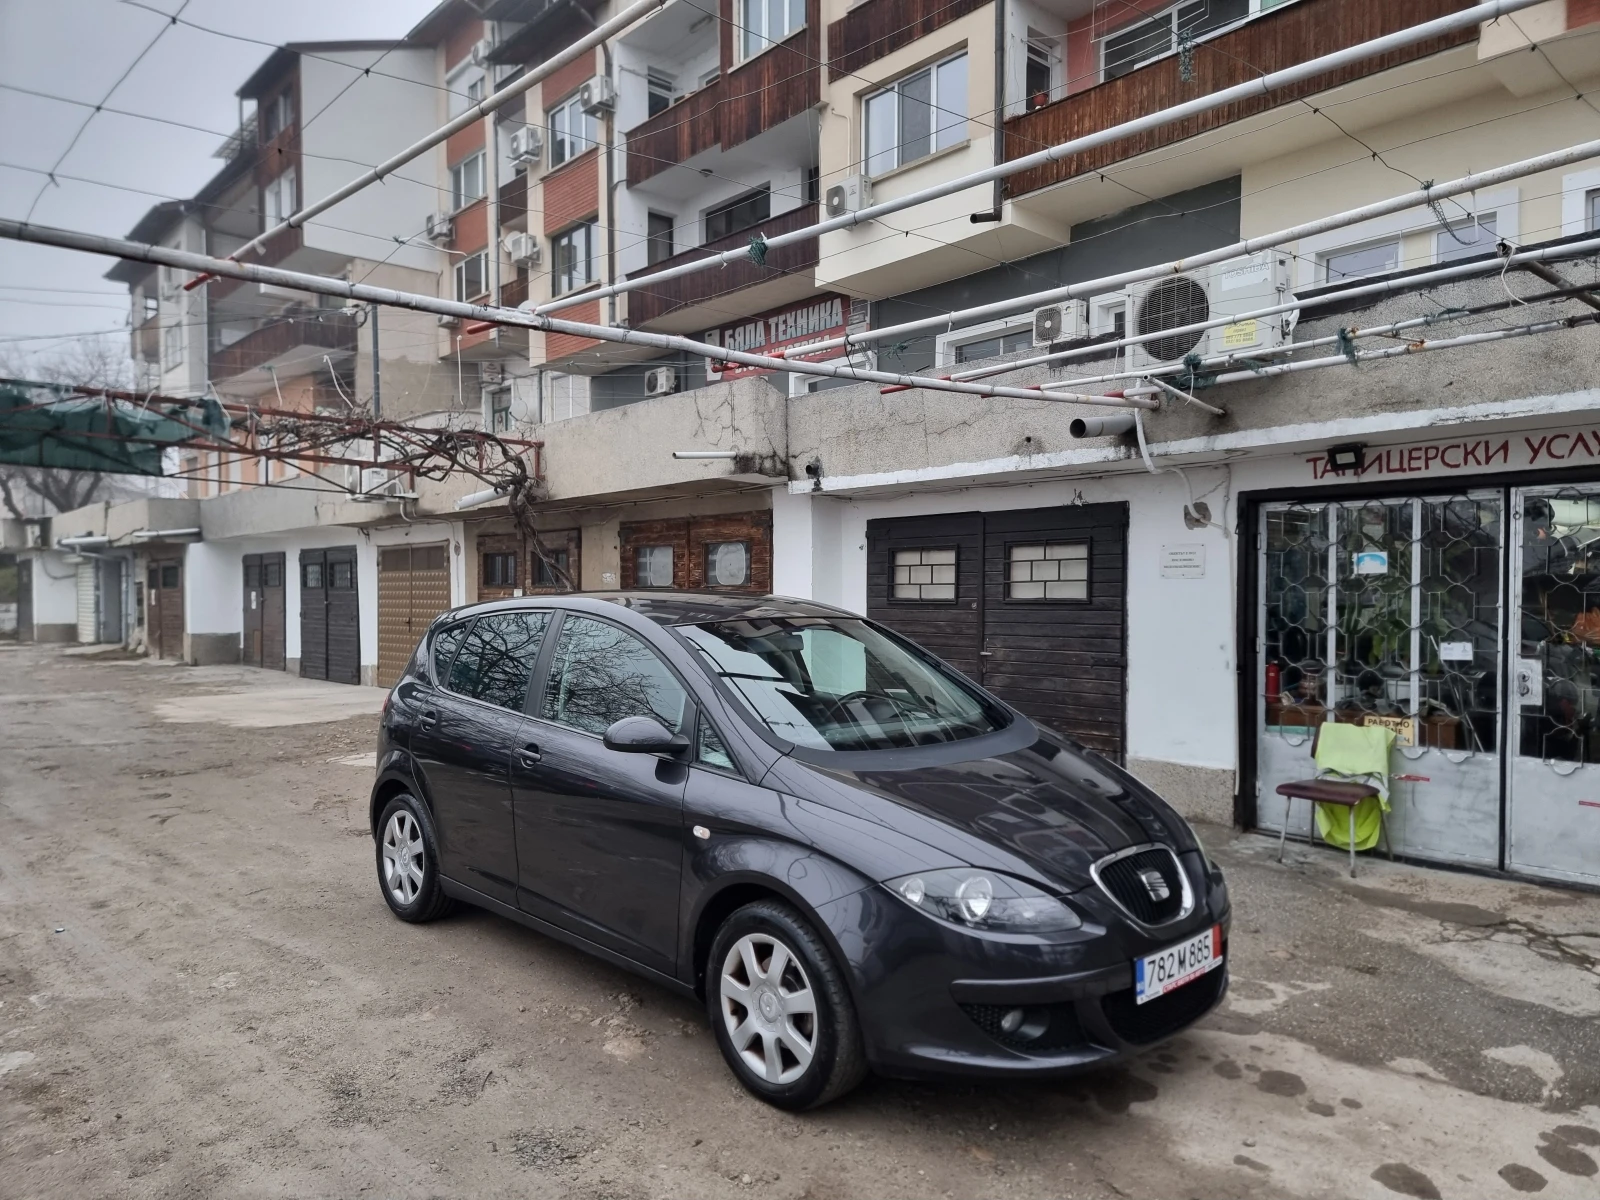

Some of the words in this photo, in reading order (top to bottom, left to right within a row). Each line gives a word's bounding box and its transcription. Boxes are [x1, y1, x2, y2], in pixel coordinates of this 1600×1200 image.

[724, 320, 766, 352] БЯЛА
[768, 298, 843, 344] ТЕХНИКА
[1306, 440, 1510, 480] ТАИЦЕРСКИ
[1148, 953, 1175, 988] 782
[1189, 935, 1210, 968] 885
